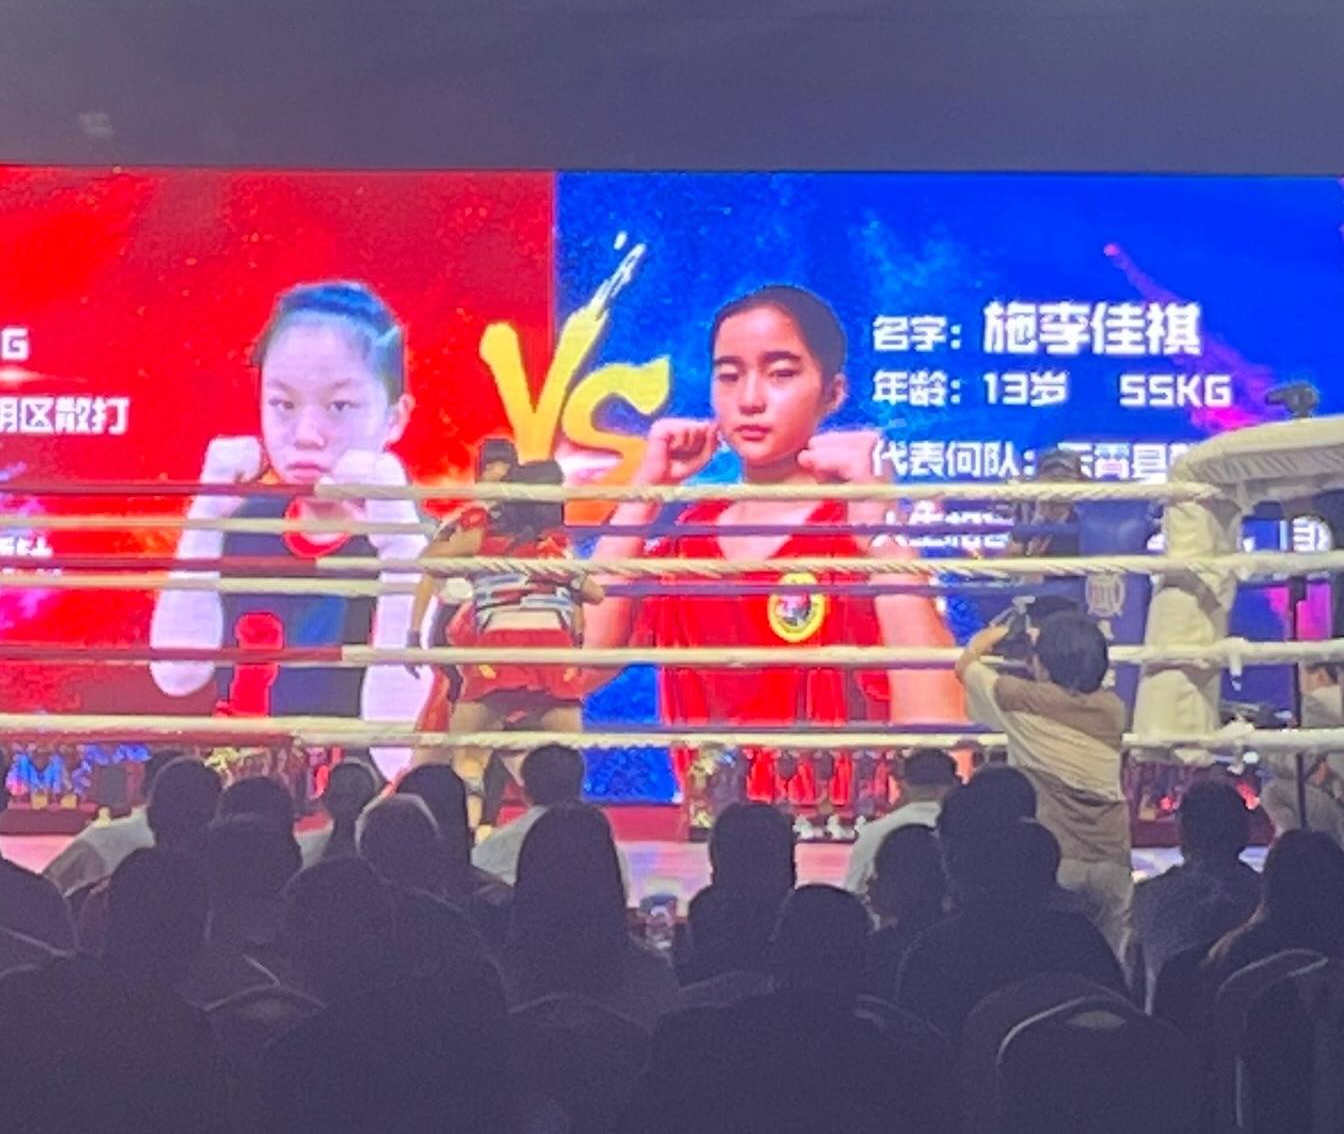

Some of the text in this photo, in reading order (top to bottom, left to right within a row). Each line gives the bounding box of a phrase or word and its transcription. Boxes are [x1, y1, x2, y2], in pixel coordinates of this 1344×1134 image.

[479, 231, 670, 522] VS
[984, 371, 1068, 407] 13岁
[1119, 374, 1233, 407] 55KG
